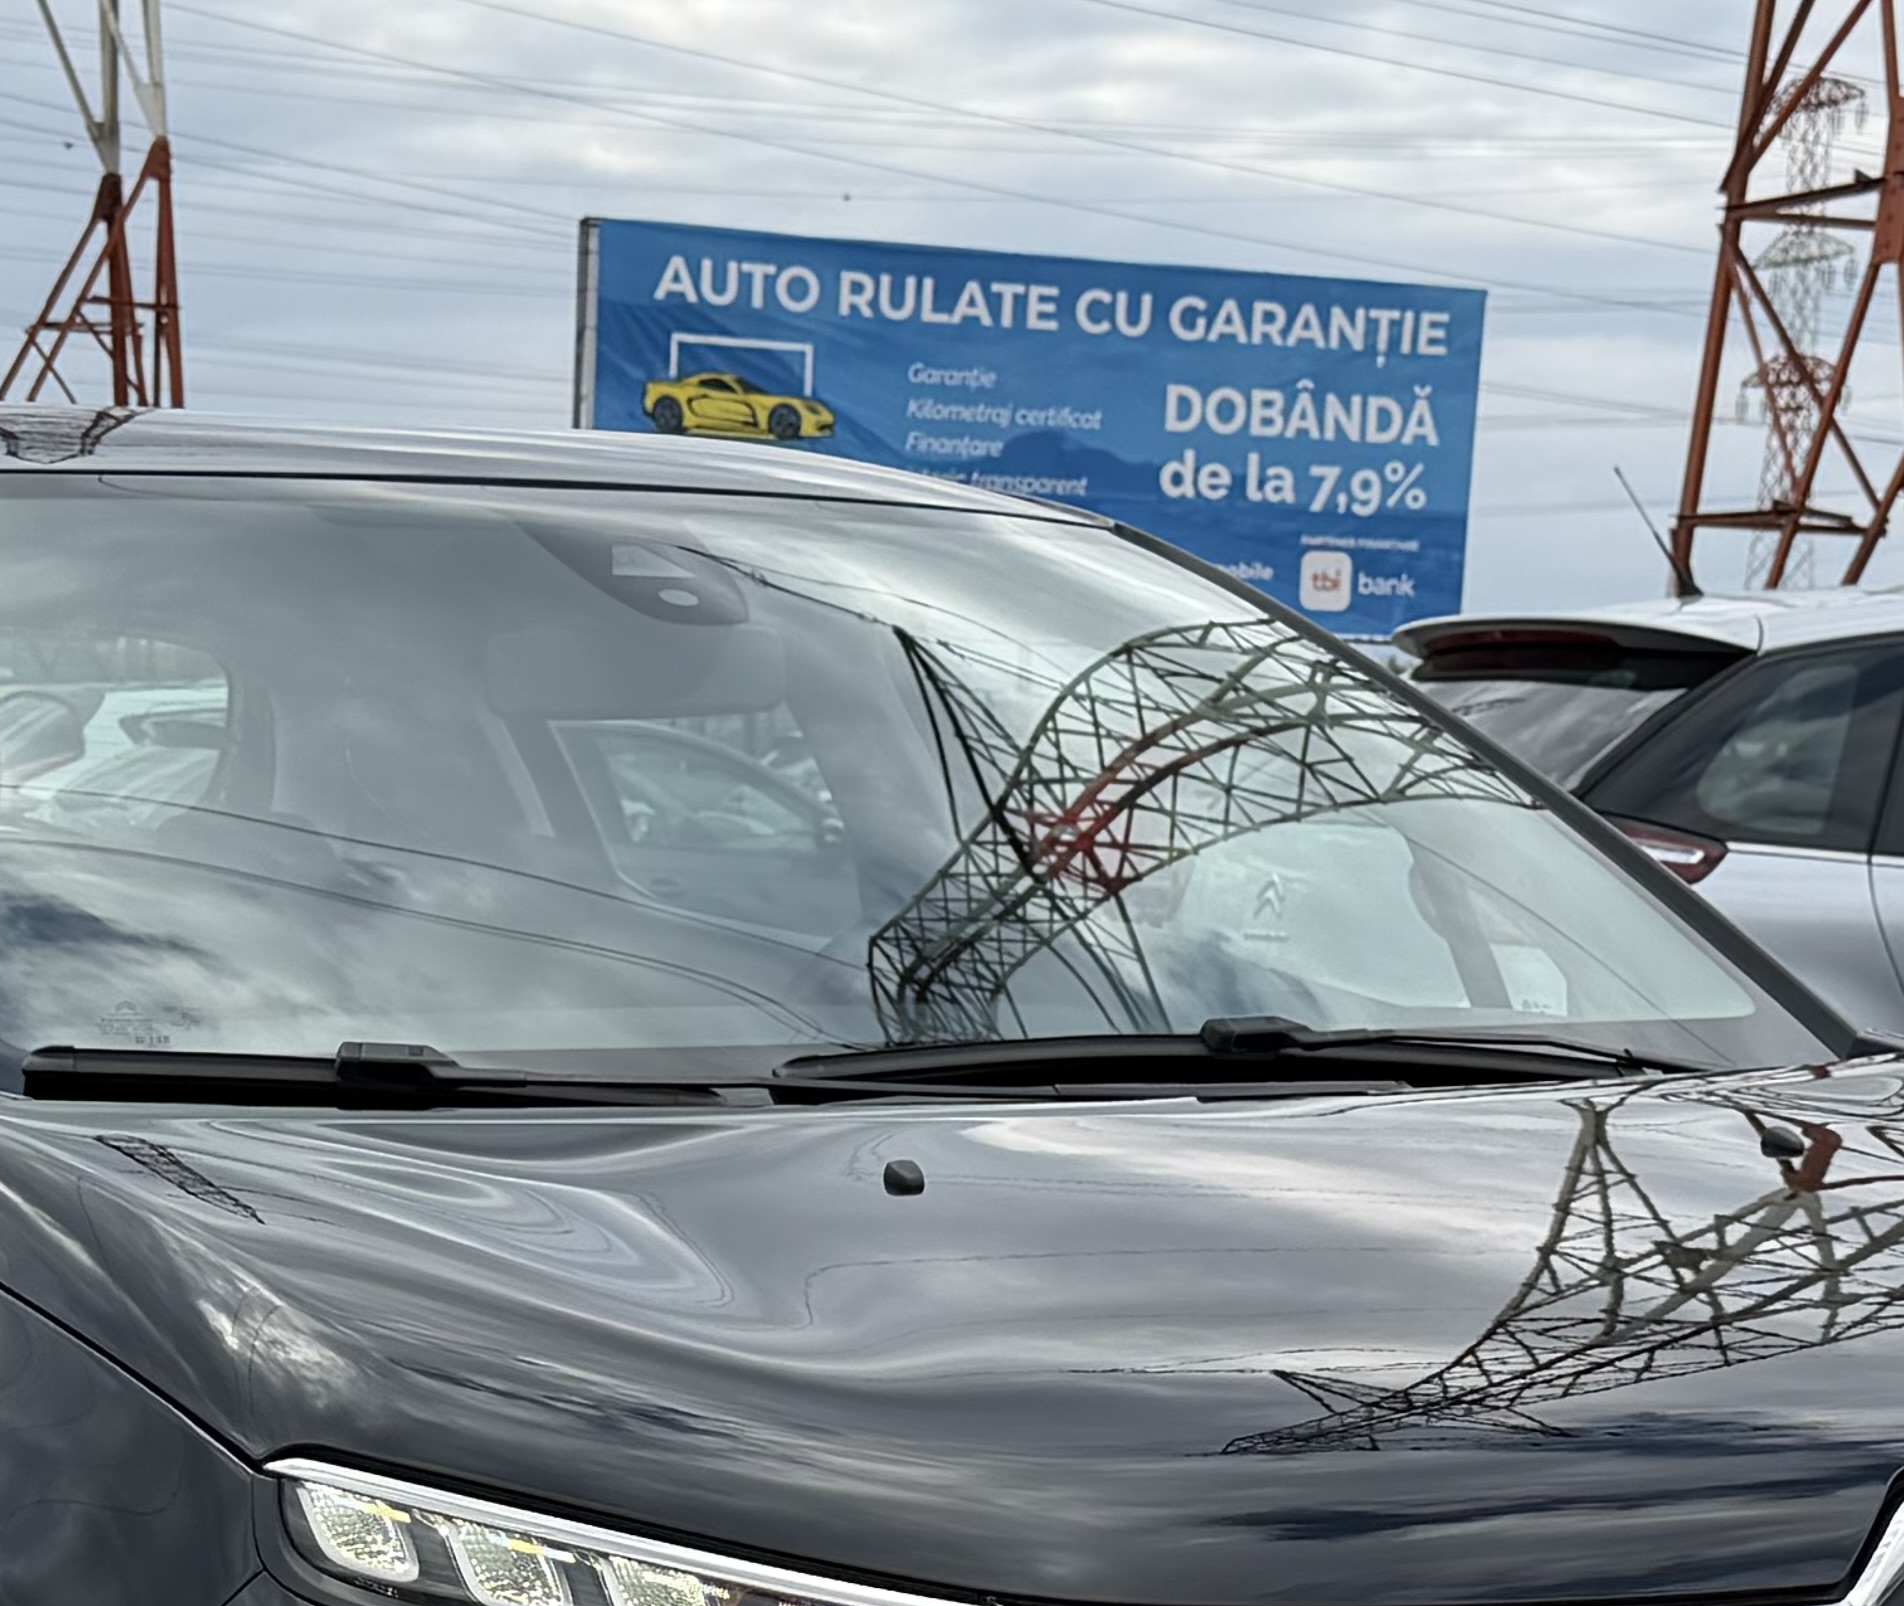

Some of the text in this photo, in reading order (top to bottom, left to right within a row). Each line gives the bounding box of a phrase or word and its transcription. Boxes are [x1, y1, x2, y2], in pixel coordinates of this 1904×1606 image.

[653, 254, 1451, 369] AUTO RULATE CU GARANȚIE
[905, 398, 1103, 431] Kilometraj certificat
[1163, 377, 1440, 448] DOBÂNDĂ
[1158, 448, 1428, 518] de la 7,9%
[1357, 572, 1417, 598] bank
